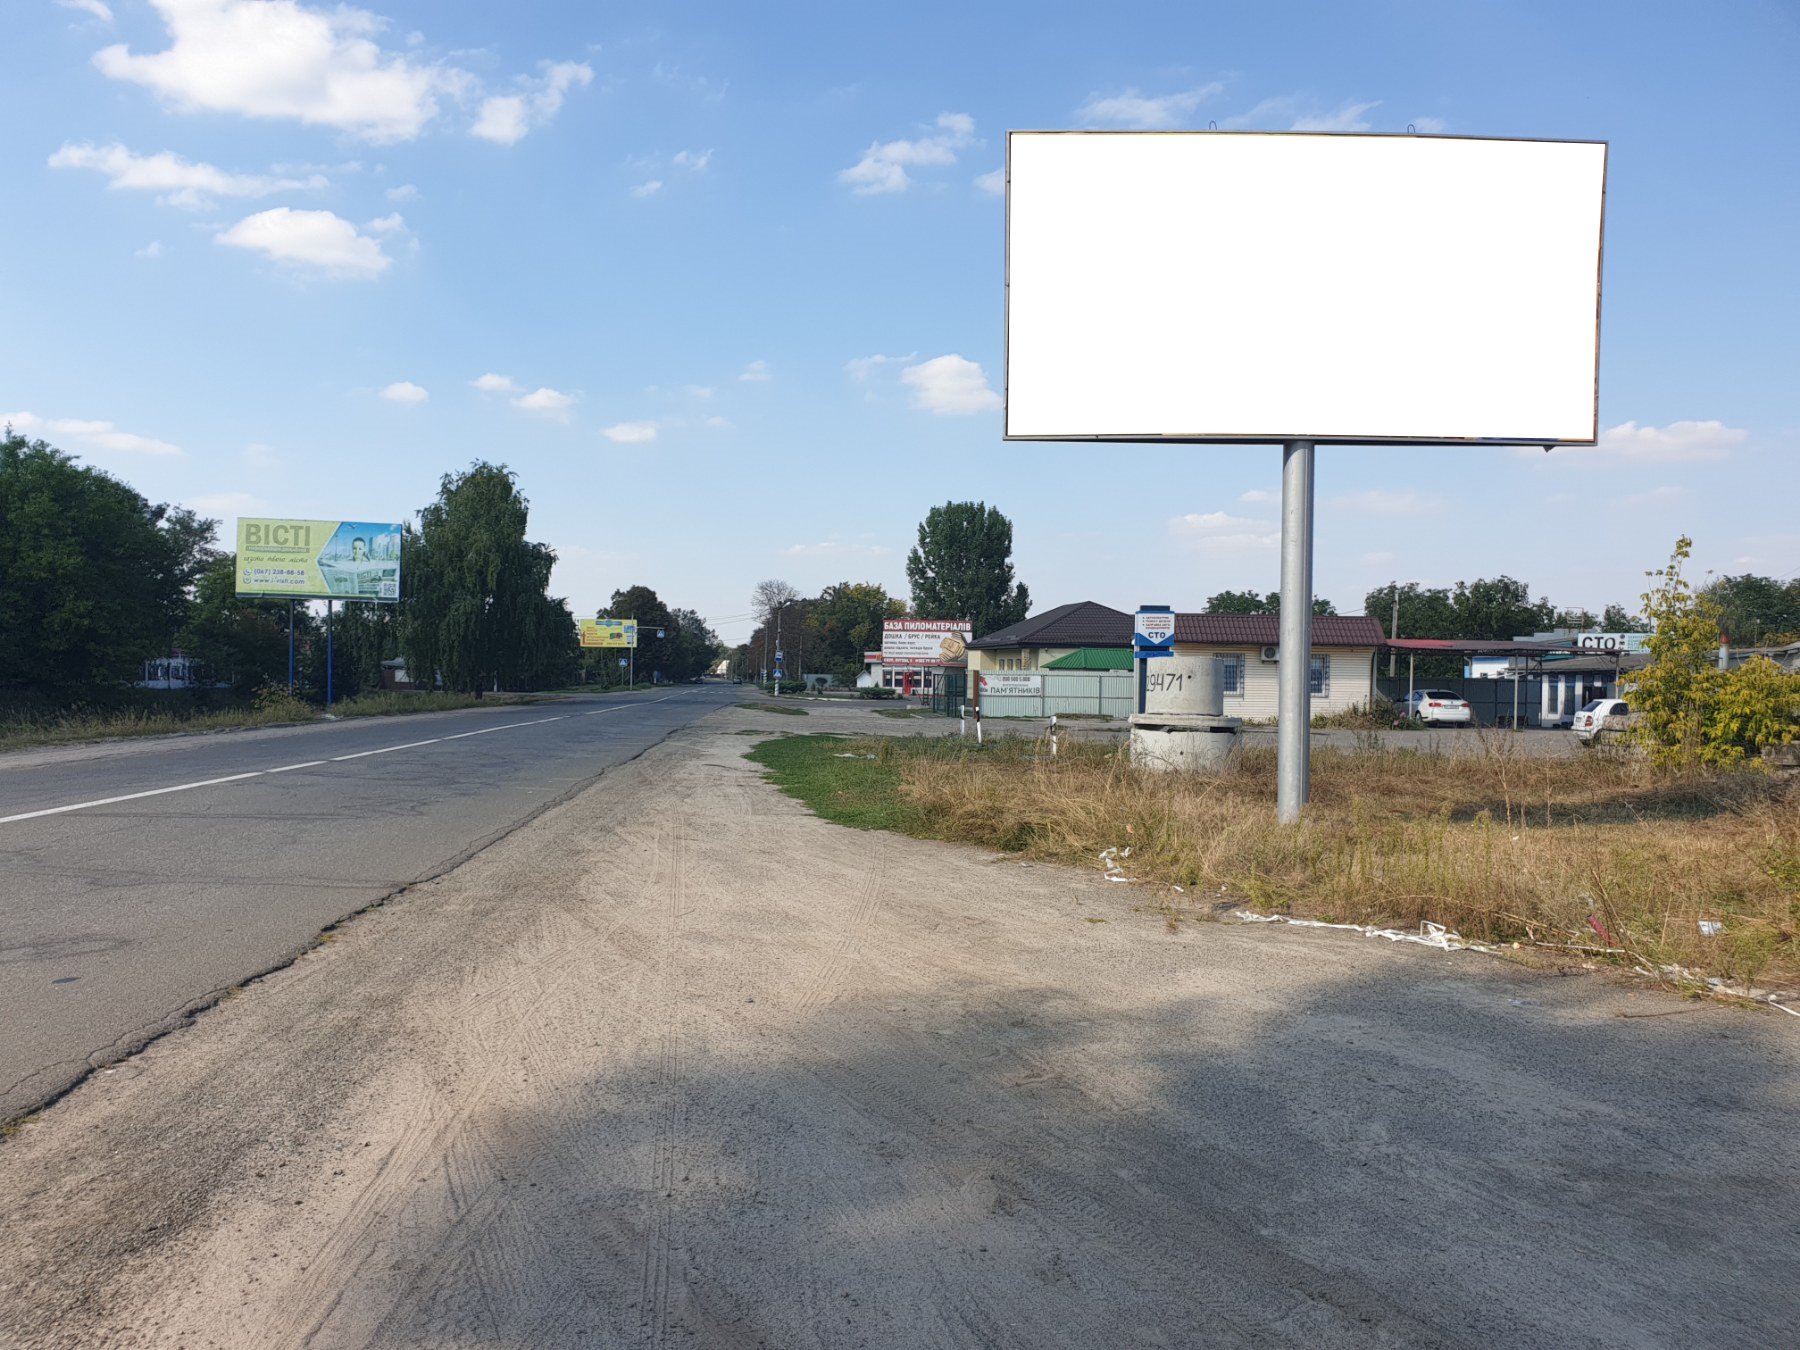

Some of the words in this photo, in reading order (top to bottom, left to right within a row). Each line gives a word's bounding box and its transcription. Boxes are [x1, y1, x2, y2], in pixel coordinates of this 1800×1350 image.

[245, 523, 311, 546] ВІСТІ
[884, 621, 903, 630] БАЗА
[904, 622, 972, 631] ПИЛОМАТЕРІАЛІВ
[1148, 631, 1166, 639] СТО
[1582, 636, 1616, 650] СТО
